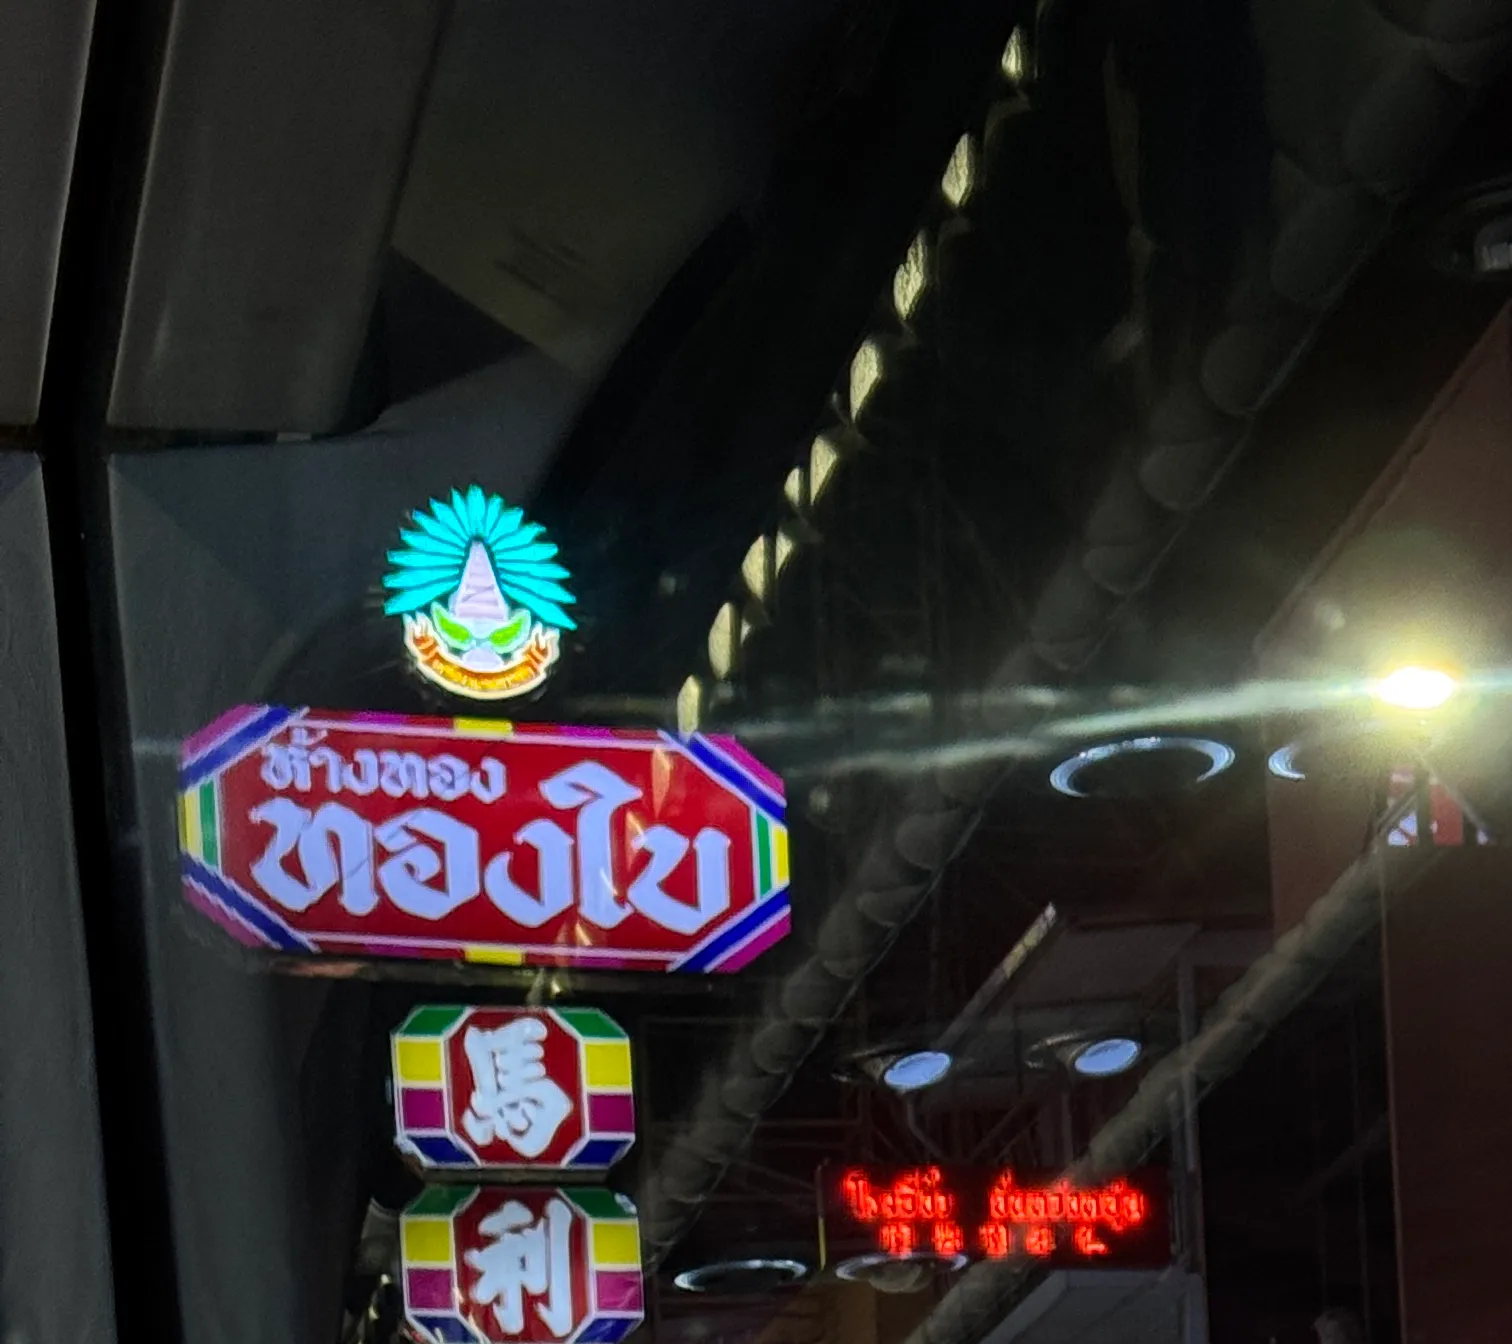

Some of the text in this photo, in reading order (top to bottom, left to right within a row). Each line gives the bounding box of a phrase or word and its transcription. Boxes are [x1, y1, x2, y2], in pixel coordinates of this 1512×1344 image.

[260, 727, 507, 803] ห้างทอง
[249, 760, 732, 936] ทองใบ
